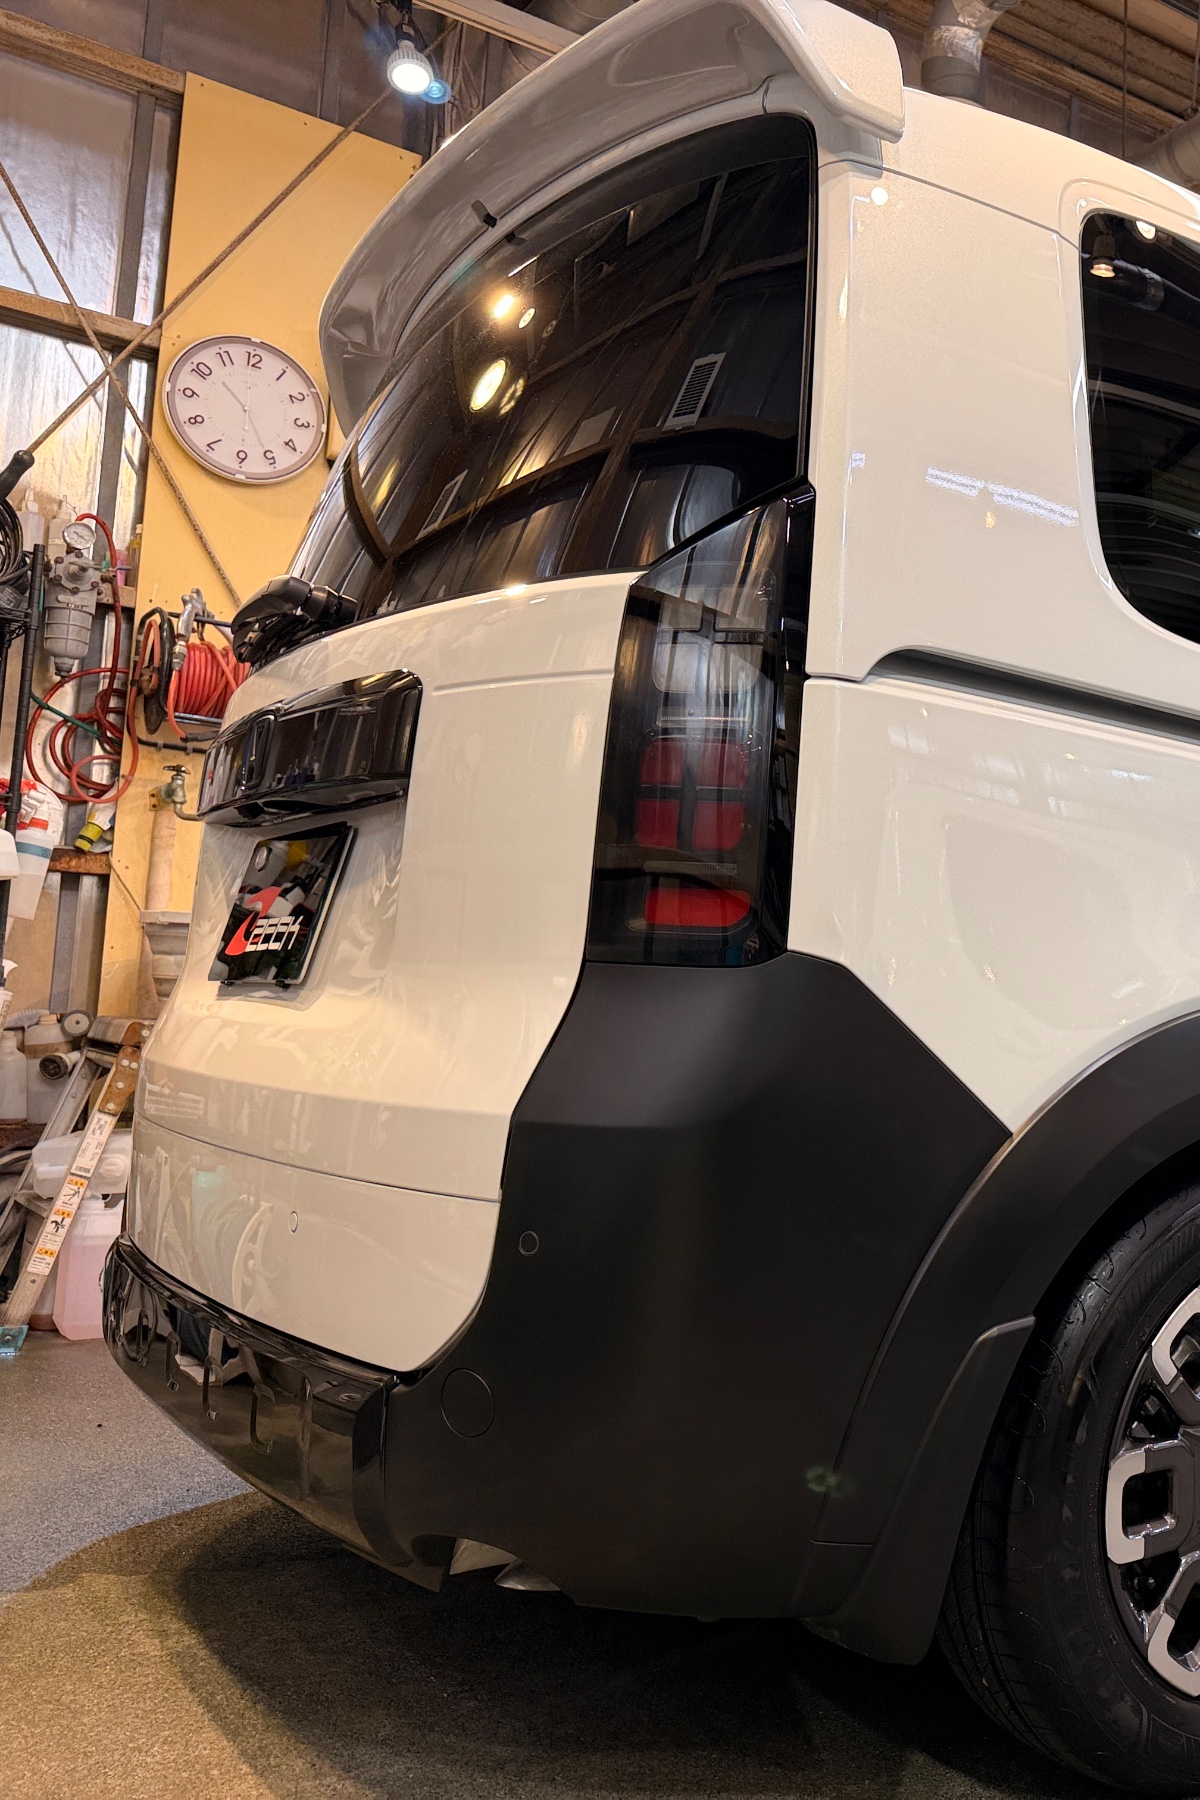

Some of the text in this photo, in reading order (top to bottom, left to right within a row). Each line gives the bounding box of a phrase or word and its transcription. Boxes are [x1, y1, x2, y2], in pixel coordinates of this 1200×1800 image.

[215, 350, 234, 367] 11
[245, 350, 263, 370] 12
[190, 361, 213, 381] 10
[275, 367, 287, 382] 1
[182, 386, 200, 399] 9
[288, 391, 306, 404] 2
[187, 413, 205, 426] 8
[293, 417, 311, 429] 3
[206, 438, 222, 452] 7
[283, 438, 298, 453] 4
[236, 449, 248, 464] 6
[263, 449, 277, 466] 5
